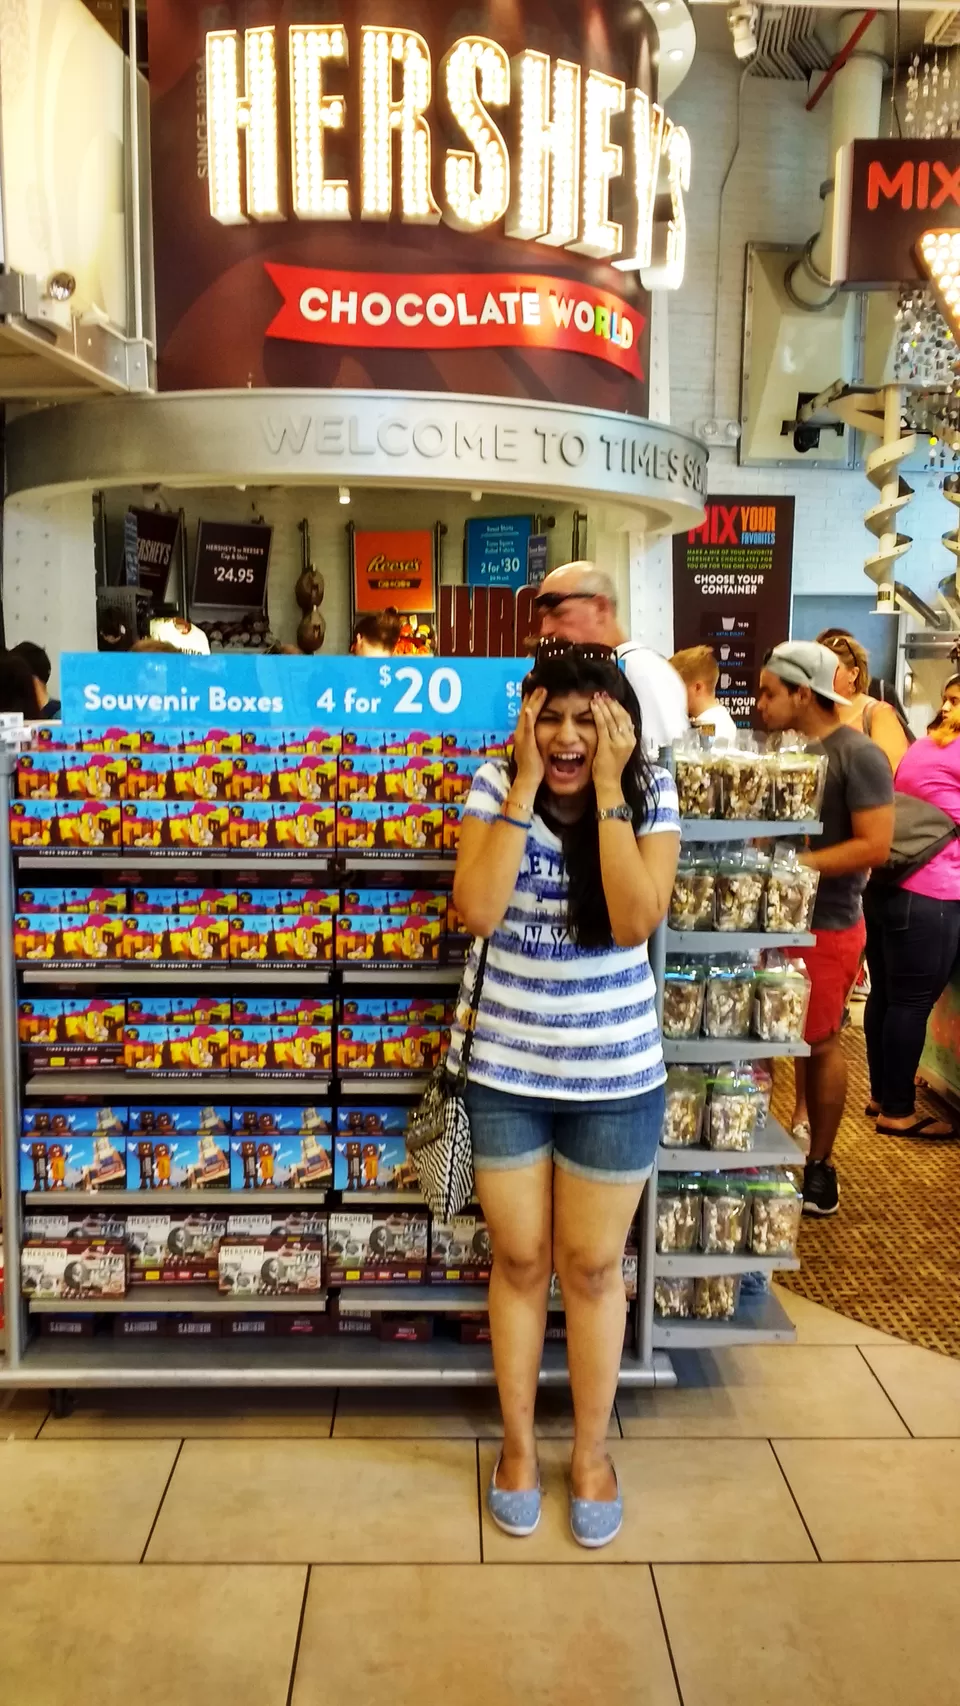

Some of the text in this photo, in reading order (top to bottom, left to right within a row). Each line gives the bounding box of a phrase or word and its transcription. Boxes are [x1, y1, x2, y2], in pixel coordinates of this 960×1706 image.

[205, 24, 692, 290] HERSHEY'S
[867, 160, 960, 212] MIX
[299, 285, 634, 350] CHOCOLATE WORLD
[262, 413, 706, 495] WELCOME TO TIMES SQ
[688, 505, 777, 545] MIX YOUR
[205, 543, 237, 553] HERSHEY'S
[740, 532, 776, 546] FAVORITES
[366, 552, 420, 573] Reese's
[480, 562, 486, 574] 2
[488, 562, 500, 574] for
[213, 566, 255, 584] $24.95
[694, 574, 764, 585] CHOOSE YOUR
[701, 584, 758, 595] CONTAINER
[84, 664, 464, 715] Souvenir Boxes 4 for $20
[505, 681, 522, 699] $5
[731, 697, 756, 707] YOUR
